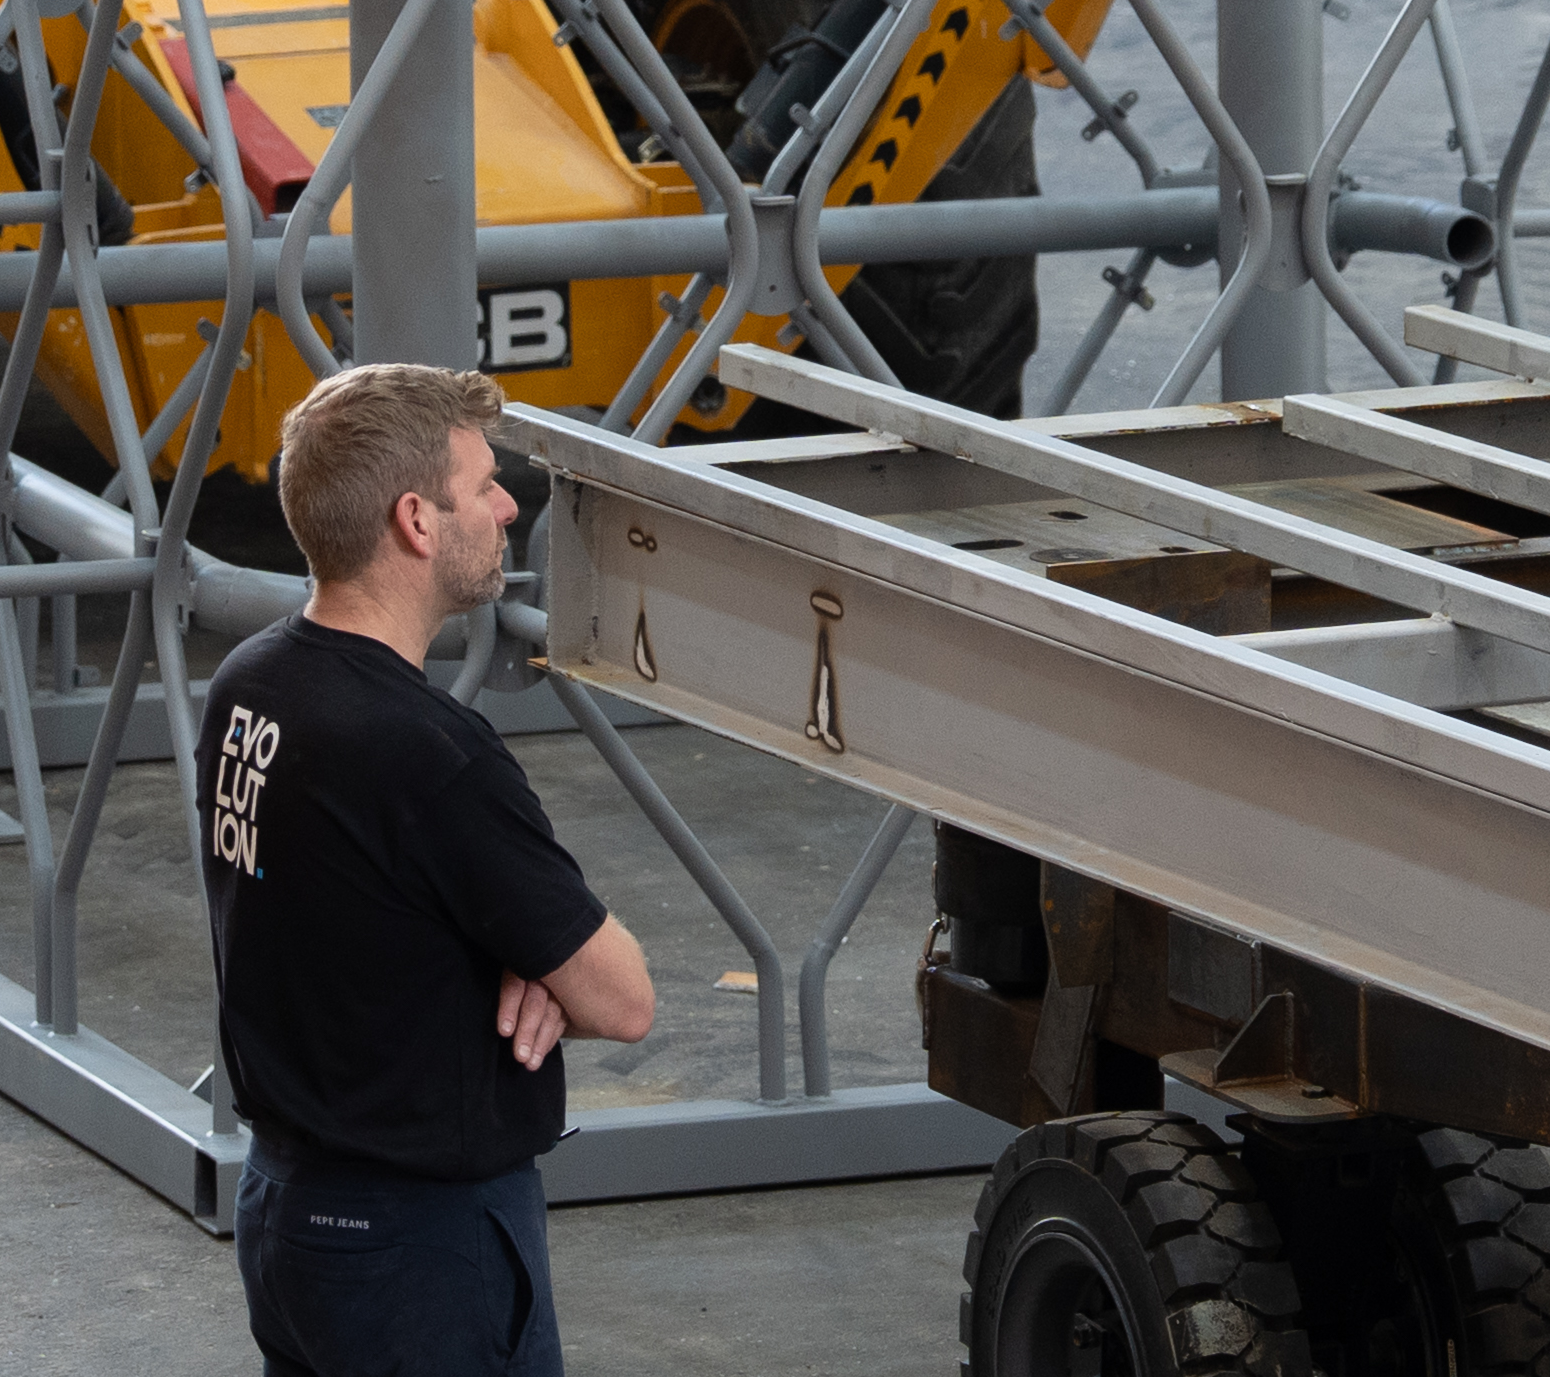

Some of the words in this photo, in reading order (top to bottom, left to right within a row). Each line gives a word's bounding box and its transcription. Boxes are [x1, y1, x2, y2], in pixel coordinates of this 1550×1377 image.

[222, 705, 280, 770] EVO
[216, 755, 267, 822] LUT
[213, 807, 264, 880] ION.
[310, 1214, 334, 1227] PEPE
[336, 1217, 370, 1230] JEANS
